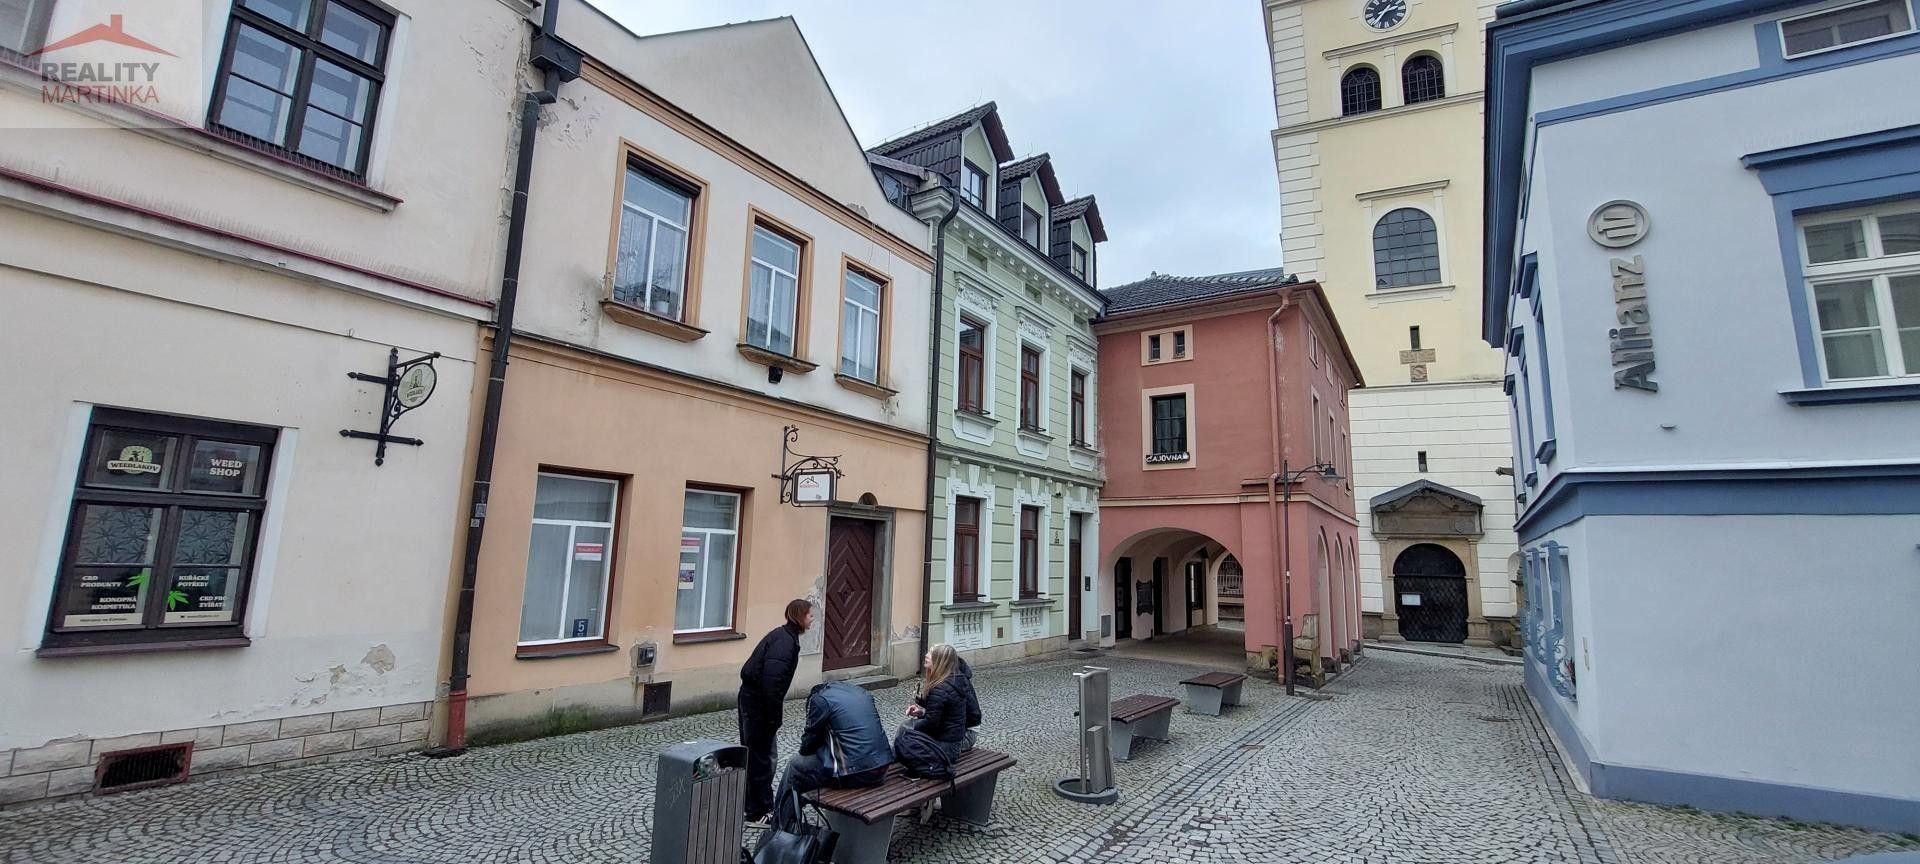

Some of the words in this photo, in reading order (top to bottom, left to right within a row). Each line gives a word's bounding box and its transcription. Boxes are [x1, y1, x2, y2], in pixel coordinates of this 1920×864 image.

[1609, 254, 1659, 393] Allianz
[210, 458, 243, 469] WEED
[209, 467, 241, 477] SHOP
[578, 620, 585, 633] 5
